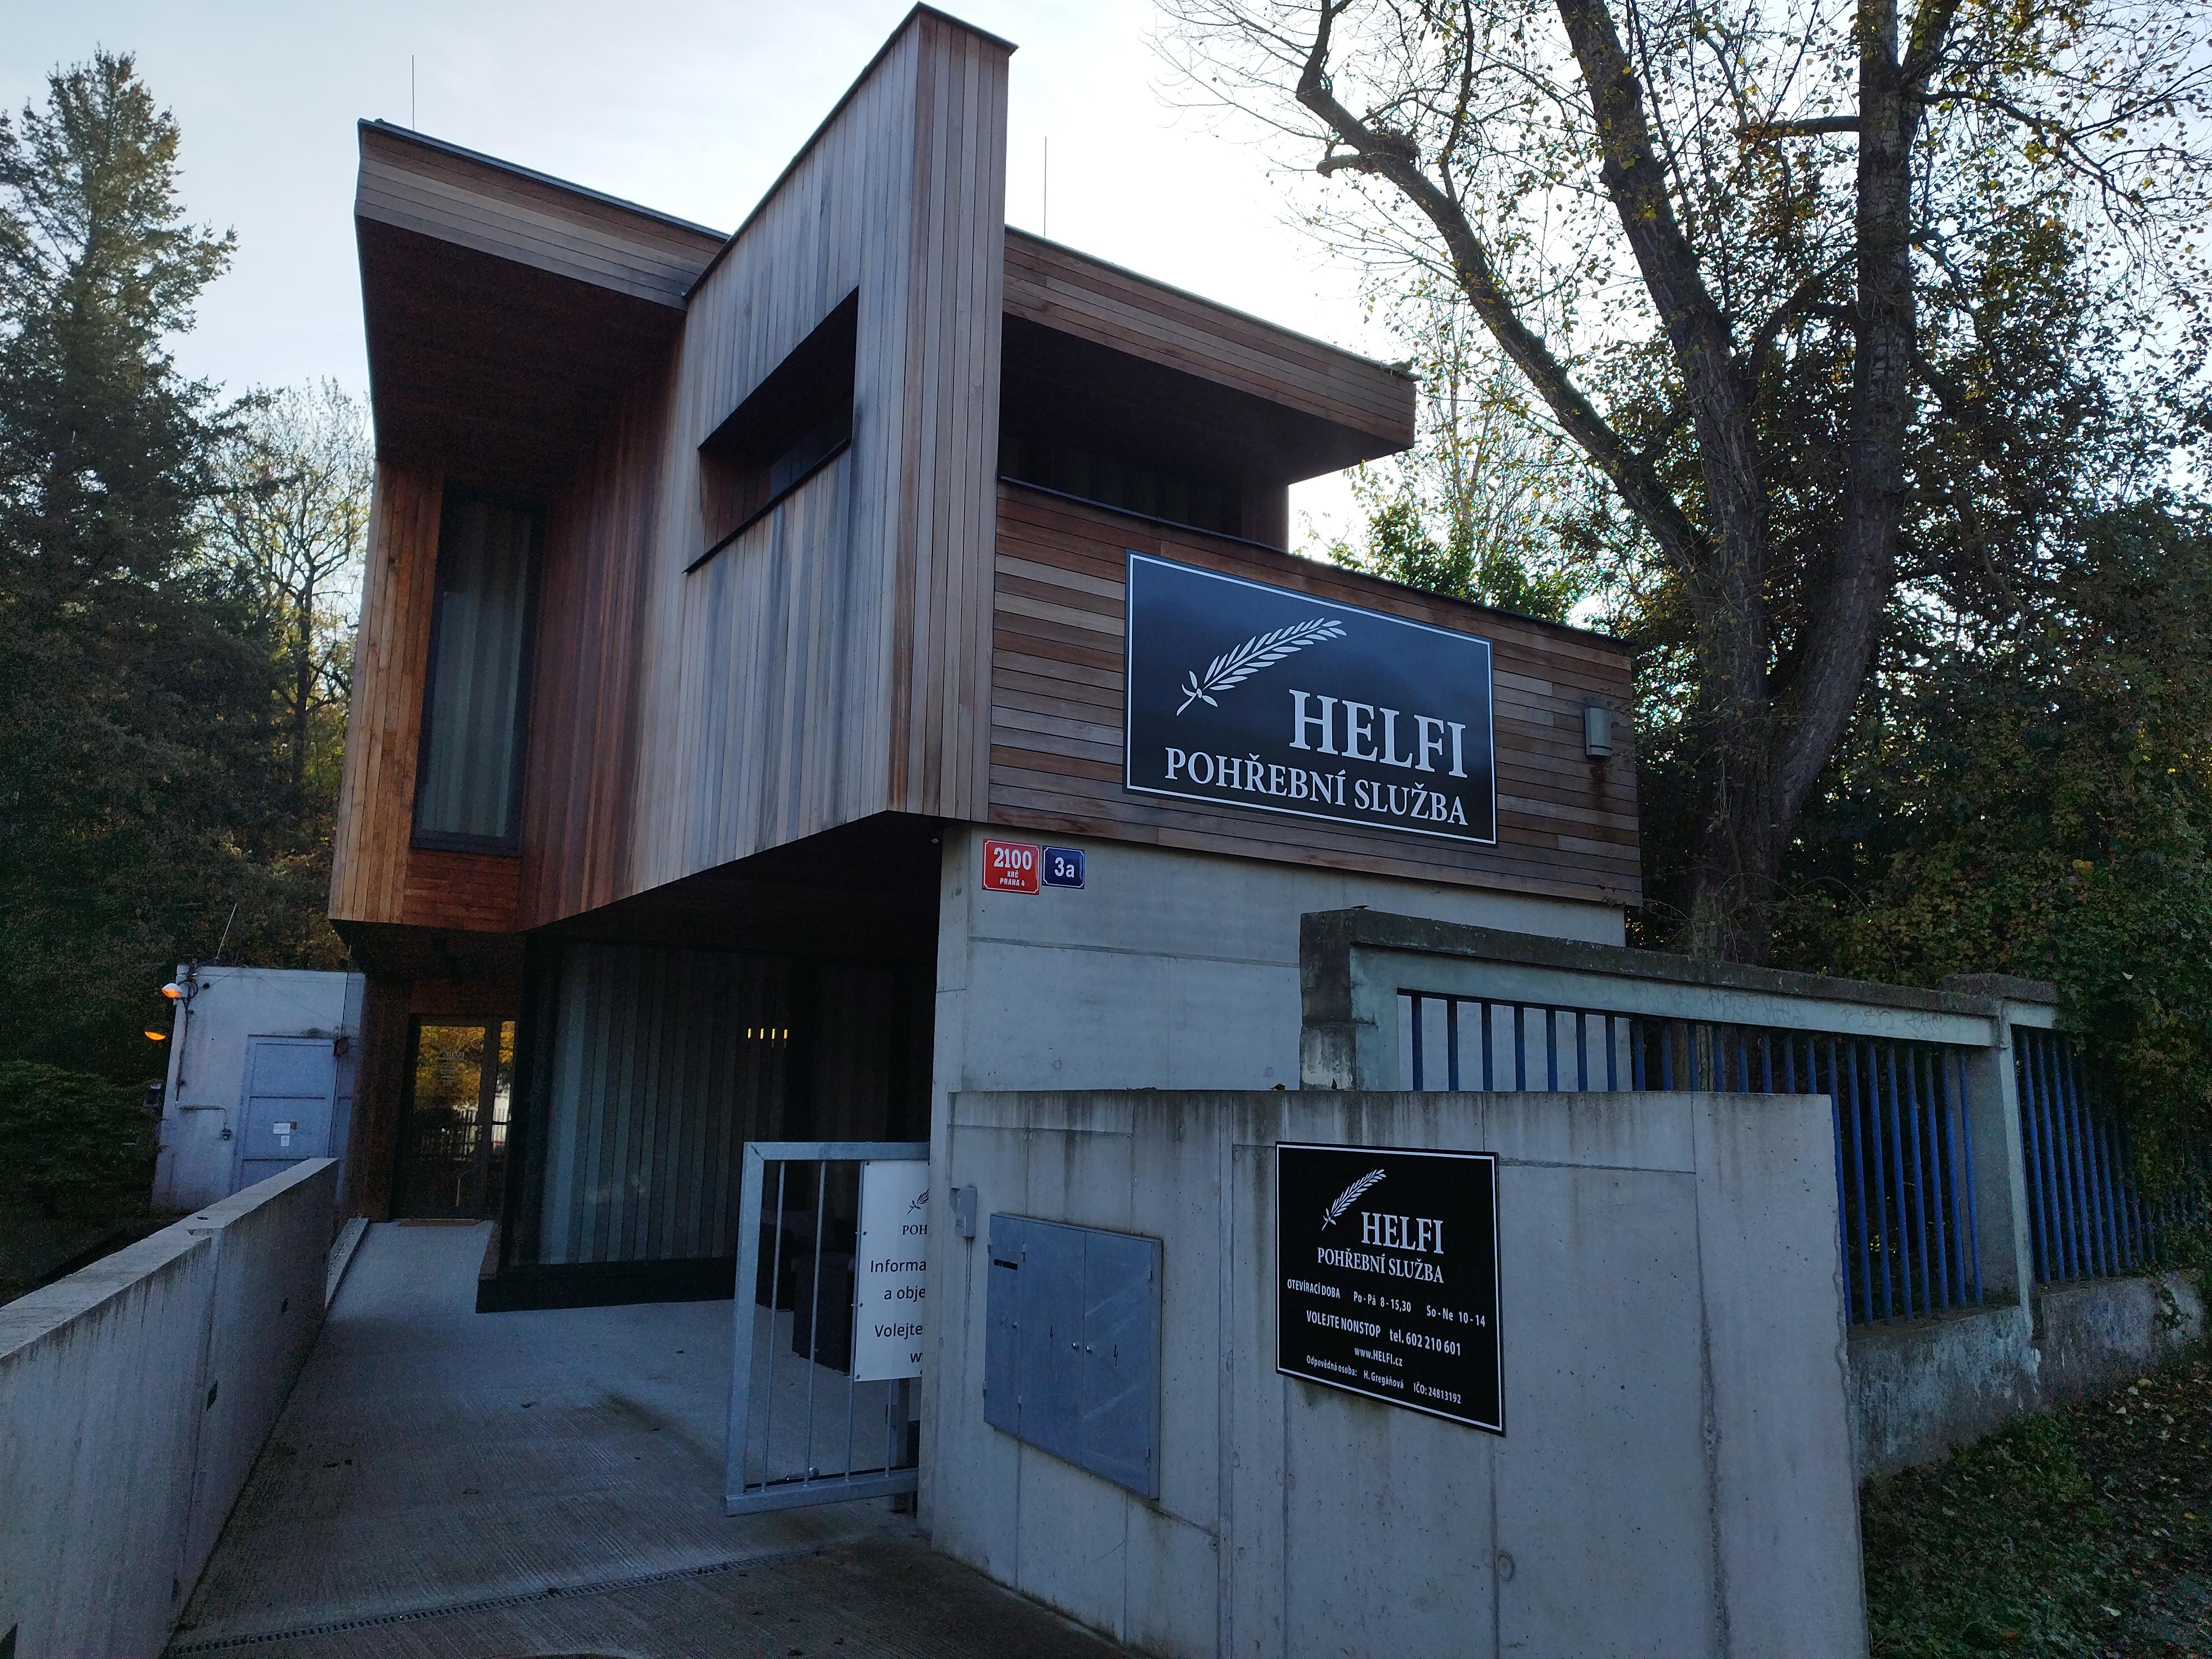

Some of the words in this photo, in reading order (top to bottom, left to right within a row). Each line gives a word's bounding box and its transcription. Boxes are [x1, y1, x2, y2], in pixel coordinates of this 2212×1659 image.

[1289, 689, 1468, 778] HELFI
[1165, 747, 1346, 806] POHŘEBNÍ
[1354, 779, 1468, 826] SLUŽBA
[993, 847, 1032, 870] 2100
[1055, 857, 1074, 878] 3a
[1000, 878, 1020, 886] PRAHA
[1007, 870, 1019, 878] KRČ
[1361, 1212, 1444, 1254] HELFI
[870, 1259, 927, 1273] Informa
[1317, 1247, 1385, 1274] POHŘEBNÍ
[1389, 1258, 1444, 1284] SLUŽBA
[884, 1290, 892, 1300] a
[896, 1285, 926, 1303] obje
[1287, 1279, 1321, 1295] OTEVÍRACÍ
[1322, 1285, 1340, 1299] DOBA
[1354, 1291, 1362, 1303] Po
[1368, 1293, 1376, 1306] Pá
[1380, 1296, 1385, 1307] 8
[1390, 1298, 1411, 1313] 15,30
[1426, 1305, 1436, 1317] So
[1442, 1308, 1453, 1321] Ne
[1458, 1311, 1468, 1323] 10
[1475, 1314, 1485, 1327] 14
[874, 1322, 924, 1340] Volejte
[1306, 1310, 1339, 1329] VOLEJTE
[1341, 1317, 1381, 1338] NONSTOP
[1389, 1328, 1404, 1344] tel.
[1406, 1332, 1422, 1348] 602
[1425, 1335, 1442, 1352] 210
[1444, 1340, 1460, 1356] 601
[1354, 1347, 1403, 1367] www.HELFI.cz
[1338, 1365, 1357, 1376] osoba:
[1364, 1370, 1370, 1380] H.
[1413, 1381, 1427, 1395] IČO:
[1428, 1386, 1461, 1404] 24813192
